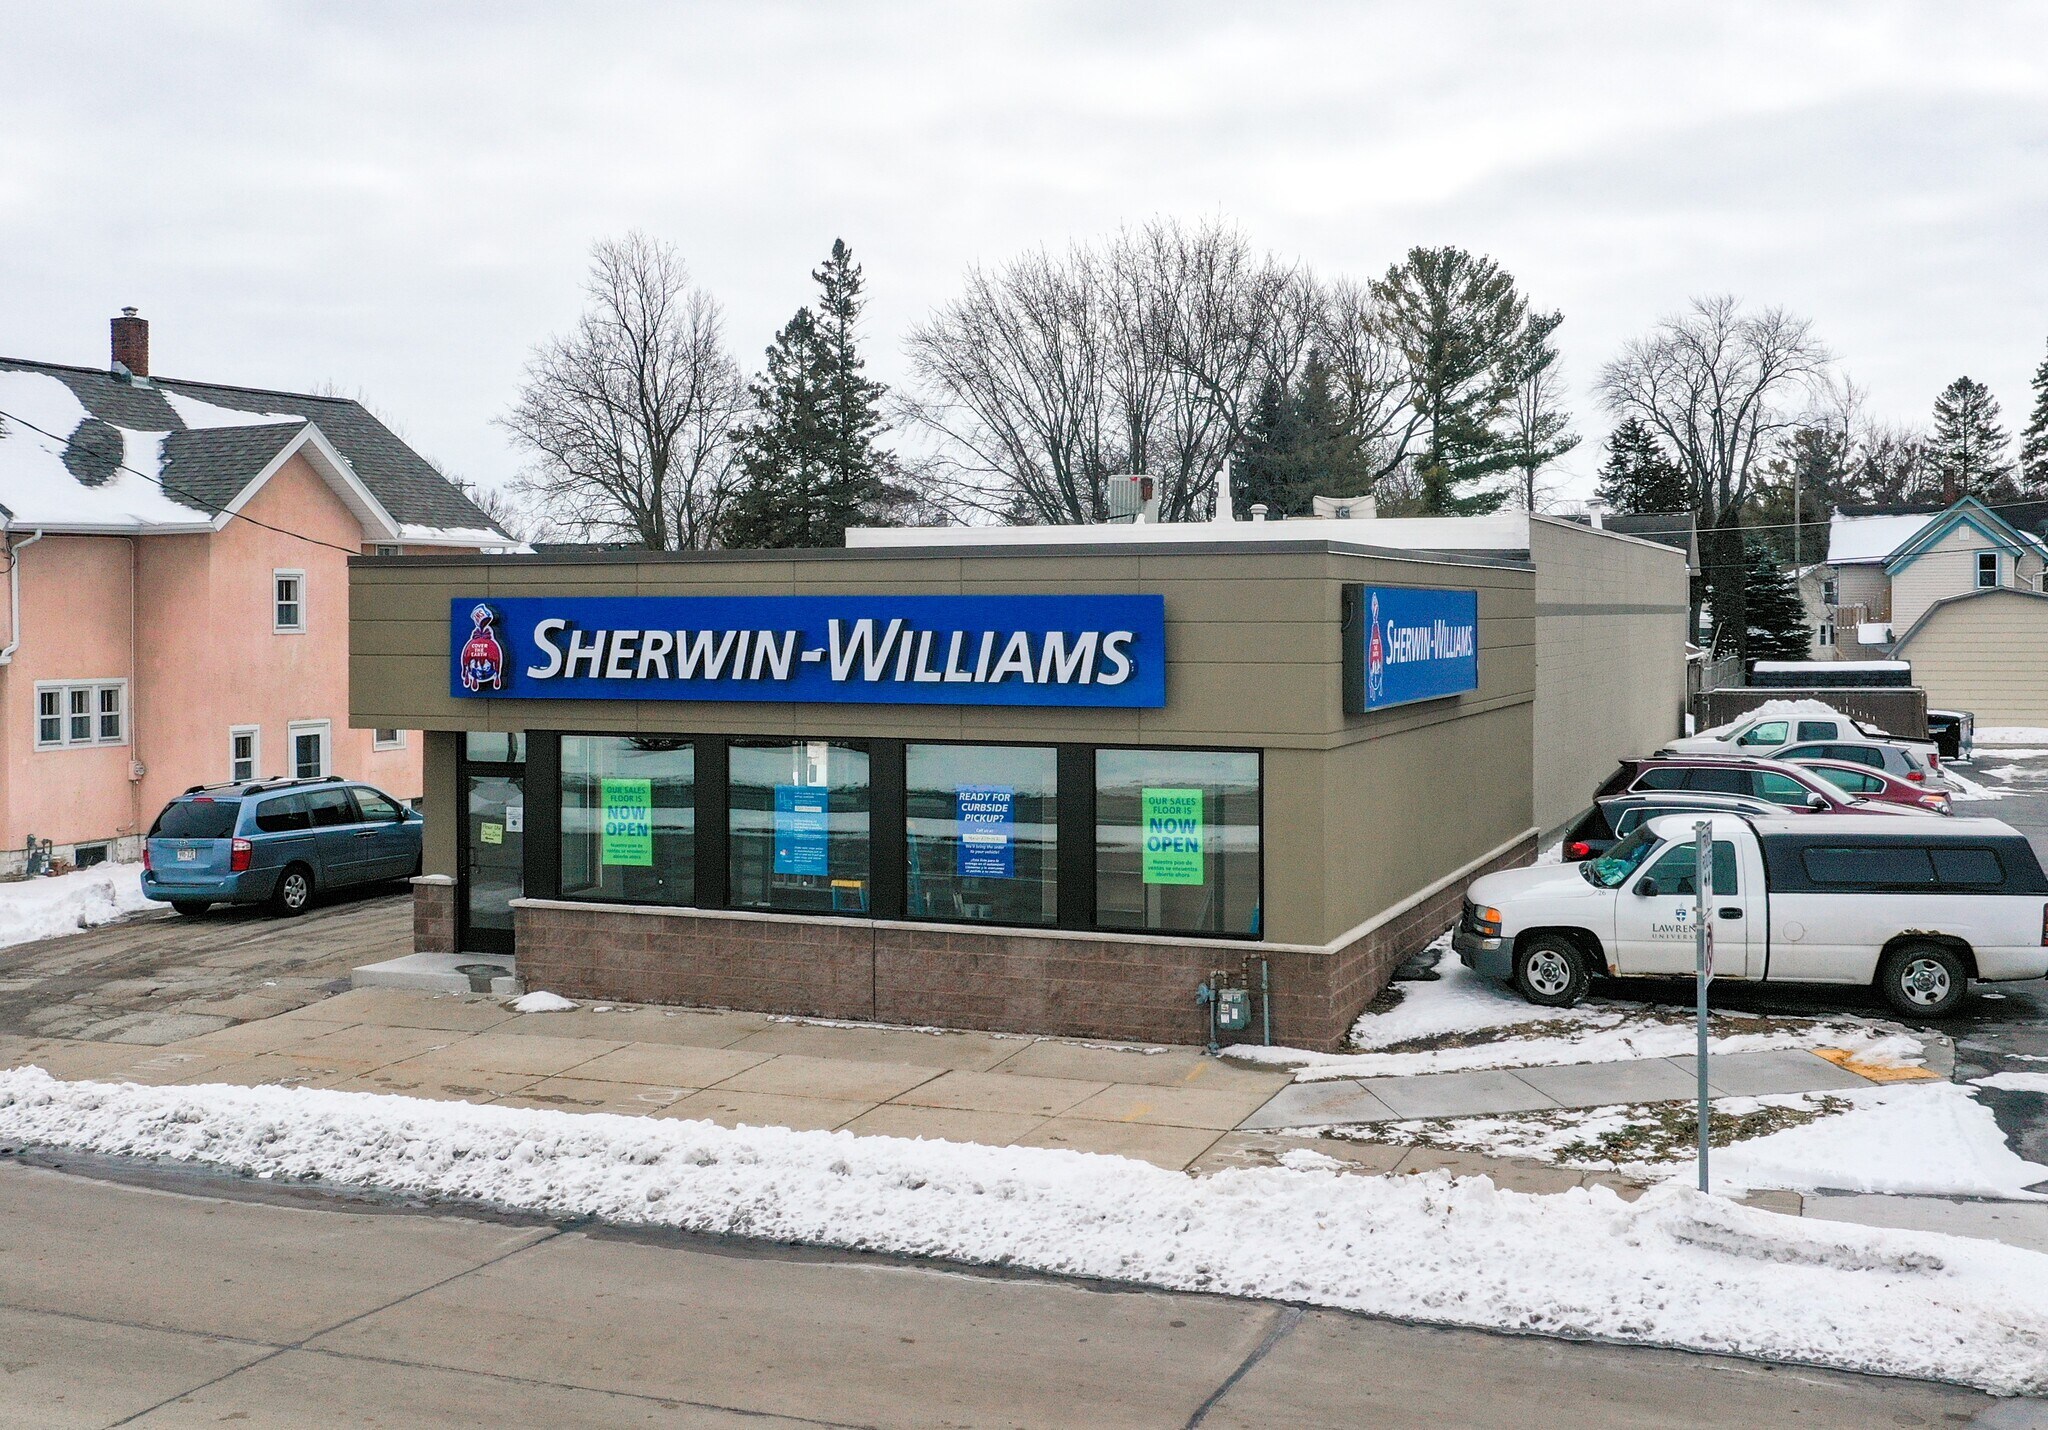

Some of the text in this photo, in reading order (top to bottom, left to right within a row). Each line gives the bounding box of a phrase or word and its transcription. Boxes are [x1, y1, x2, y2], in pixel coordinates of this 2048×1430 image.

[1386, 619, 1473, 665] SHERWIN-WILLIAMS
[527, 618, 1133, 686] SHERWIN-WILLIAMS
[959, 792, 1011, 802] READY FOR
[1148, 797, 1196, 806] OUR SALES
[608, 805, 646, 820] NOW
[961, 803, 1009, 813] CURBSIDE
[1153, 806, 1192, 815] FLOOR IS
[964, 813, 1005, 823] PICKUP?
[606, 822, 648, 837] OPEN
[1150, 818, 1197, 834] NOW
[1147, 836, 1198, 853] OPEN
[1652, 923, 1696, 932] LAWREN
